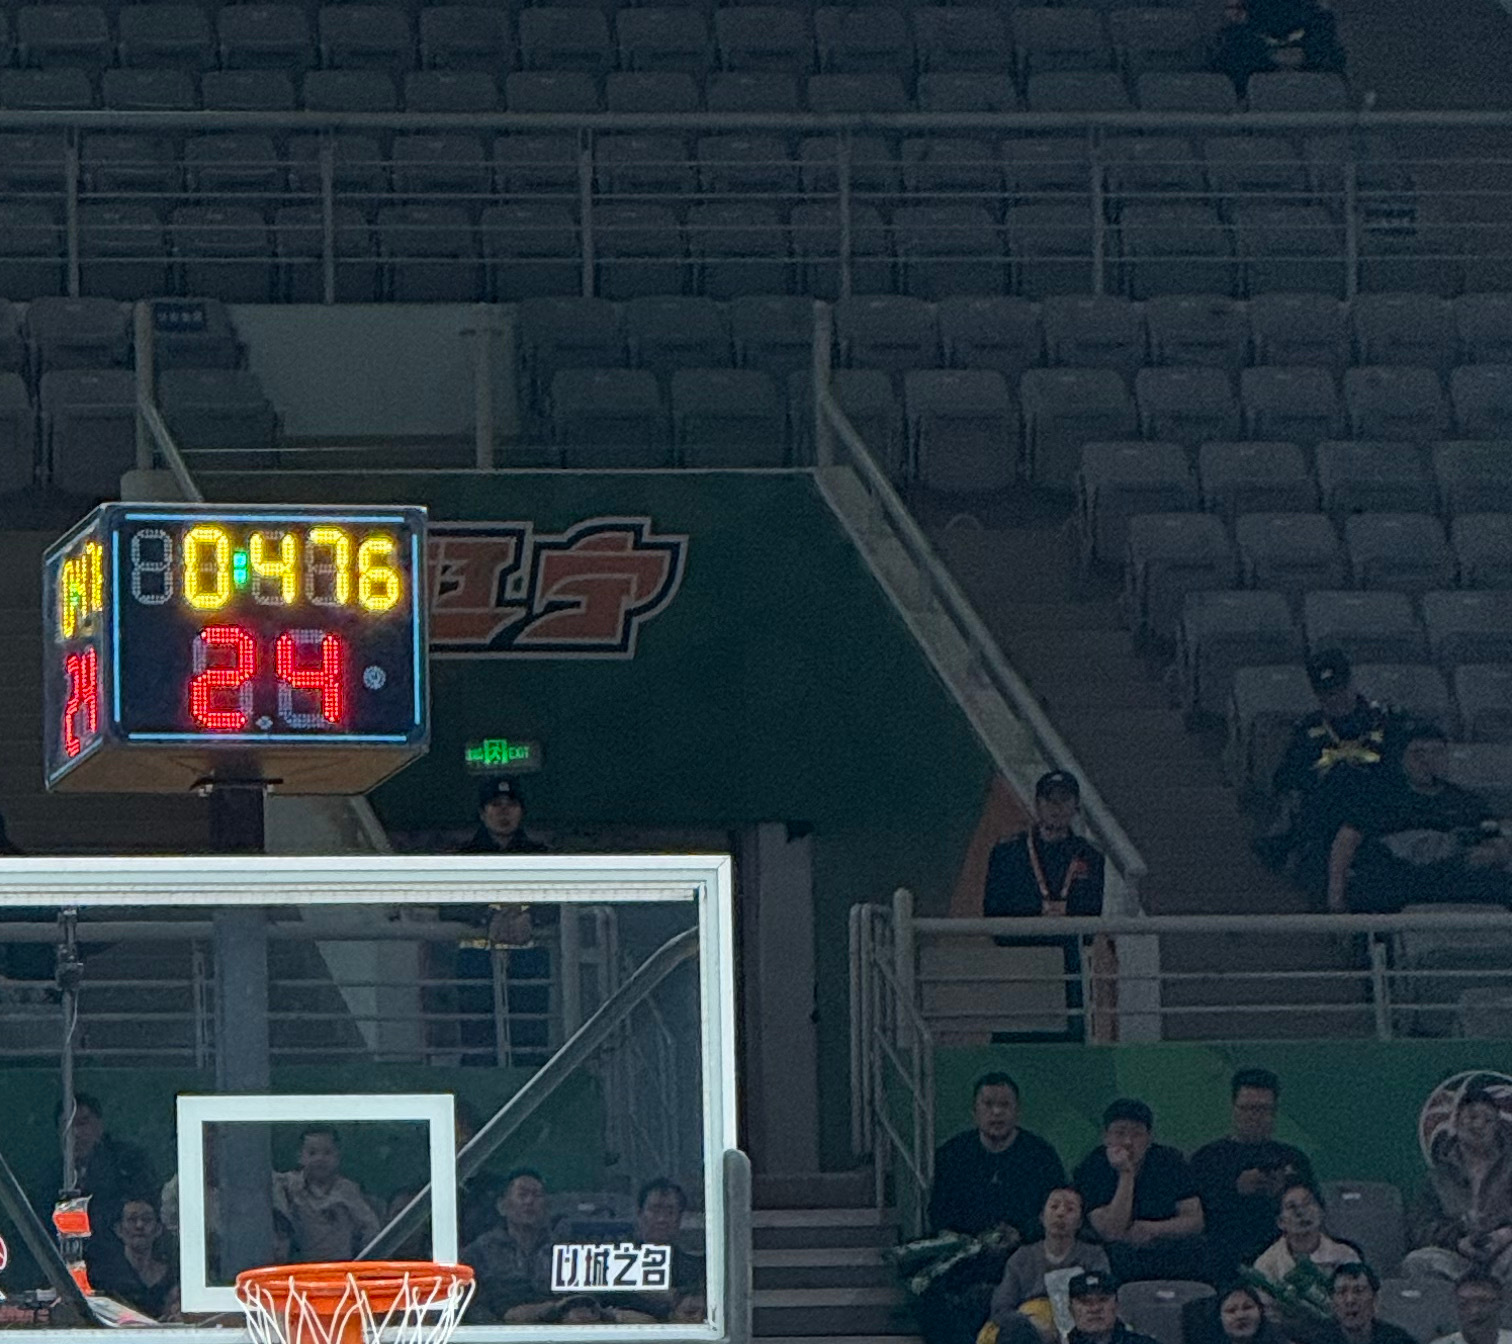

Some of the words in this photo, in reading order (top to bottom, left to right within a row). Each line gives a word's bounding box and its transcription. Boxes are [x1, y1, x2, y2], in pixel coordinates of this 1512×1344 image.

[189, 623, 343, 729] 24
[553, 1244, 669, 1289] 以城之名
